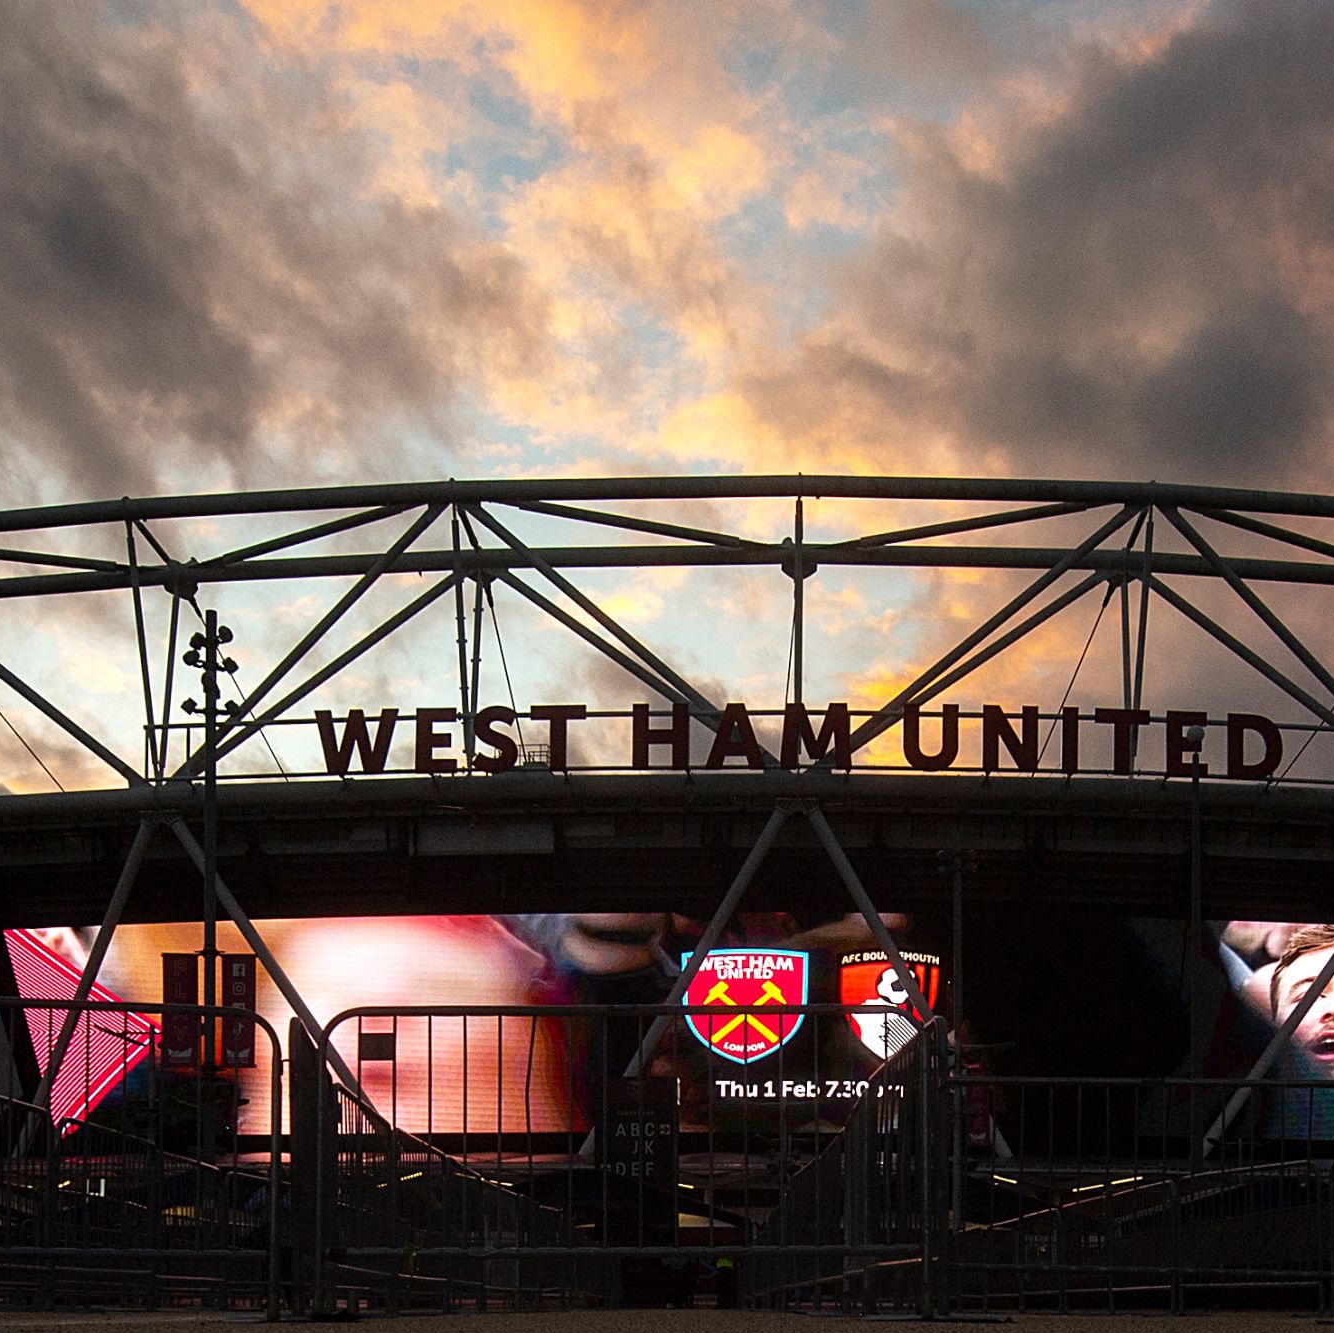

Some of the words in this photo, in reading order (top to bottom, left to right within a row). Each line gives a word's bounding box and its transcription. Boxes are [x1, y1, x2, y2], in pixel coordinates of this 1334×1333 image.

[313, 705, 587, 775] WEST
[632, 702, 852, 771] HAM
[902, 703, 1284, 780] UNITED
[699, 956, 747, 971] WEST
[749, 956, 794, 971] HAM
[841, 953, 861, 965] AFC
[716, 968, 774, 980] UNITED
[715, 1080, 758, 1098] Thu
[763, 1080, 776, 1098] 1
[781, 1080, 821, 1098] Feb
